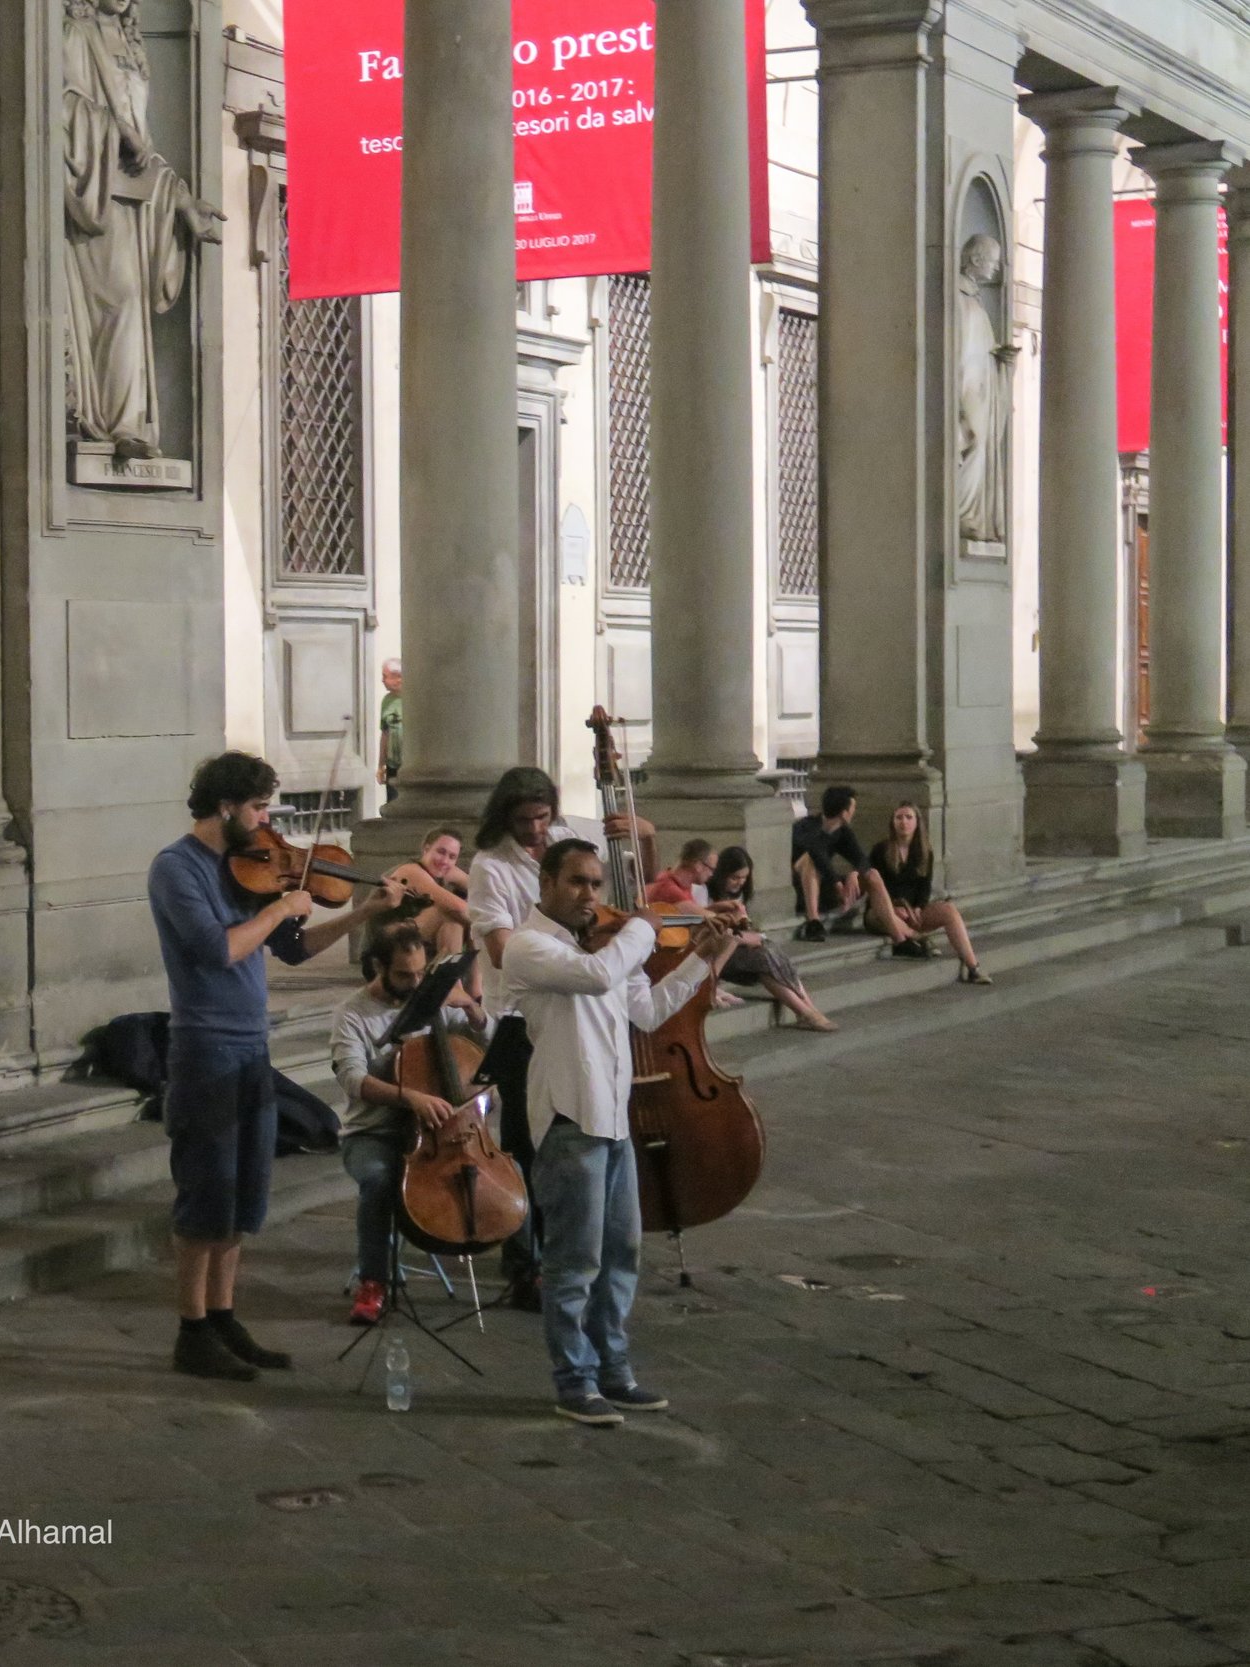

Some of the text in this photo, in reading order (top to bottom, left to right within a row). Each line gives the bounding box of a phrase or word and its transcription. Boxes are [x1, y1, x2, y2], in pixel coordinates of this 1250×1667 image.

[551, 21, 654, 71] prest
[576, 106, 605, 129] da
[612, 99, 654, 125] salv
[529, 235, 570, 249] LUGLIO
[571, 233, 596, 246] 2017
